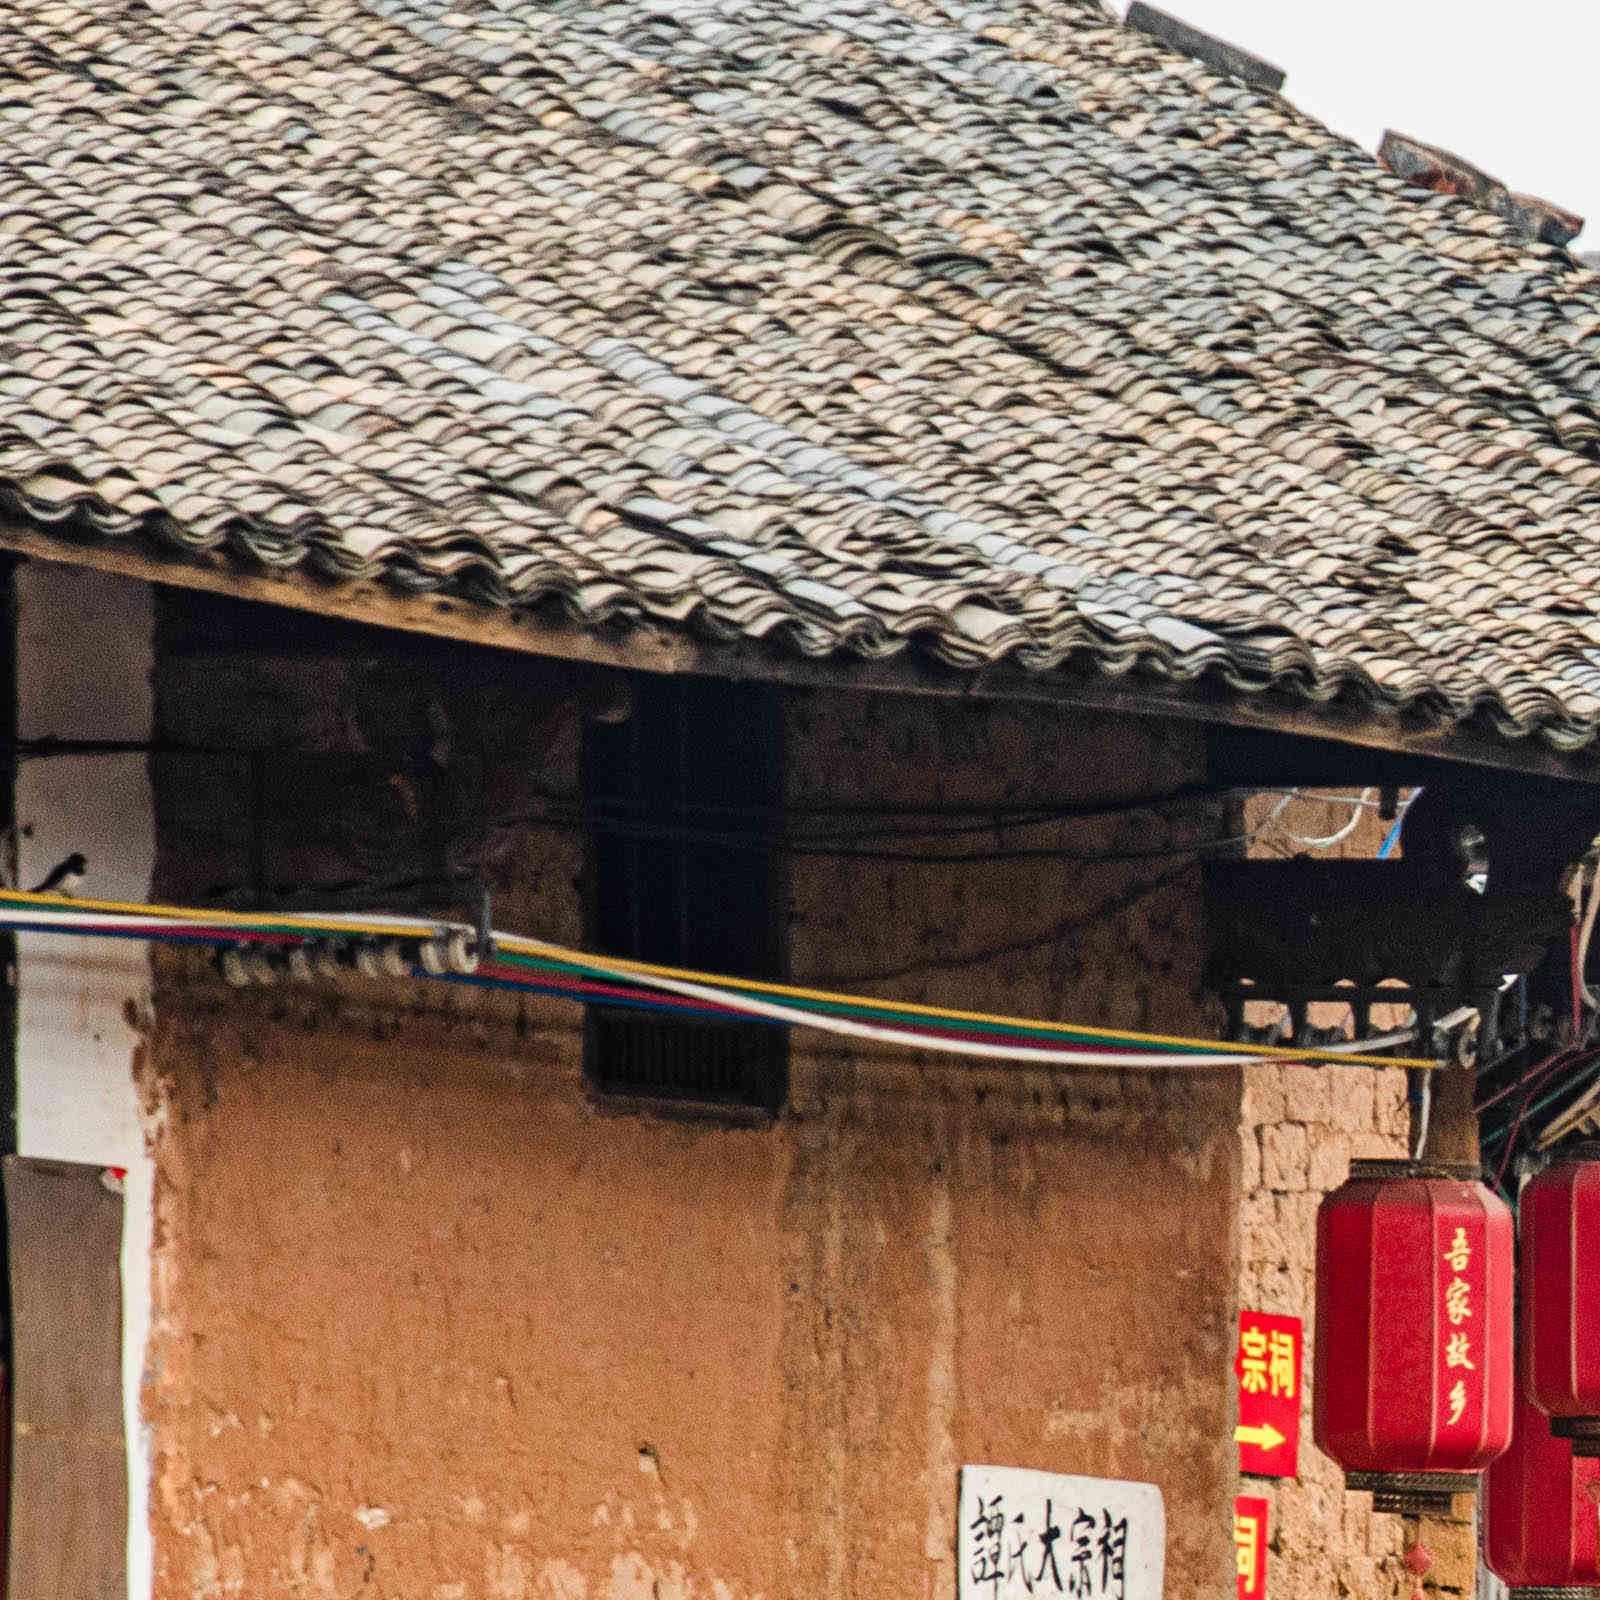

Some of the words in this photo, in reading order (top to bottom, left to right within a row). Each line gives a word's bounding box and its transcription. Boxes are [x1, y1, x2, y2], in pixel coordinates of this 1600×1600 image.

[1241, 1326, 1296, 1399] 宗祠
[1443, 1227, 1476, 1426] 吾家故乡
